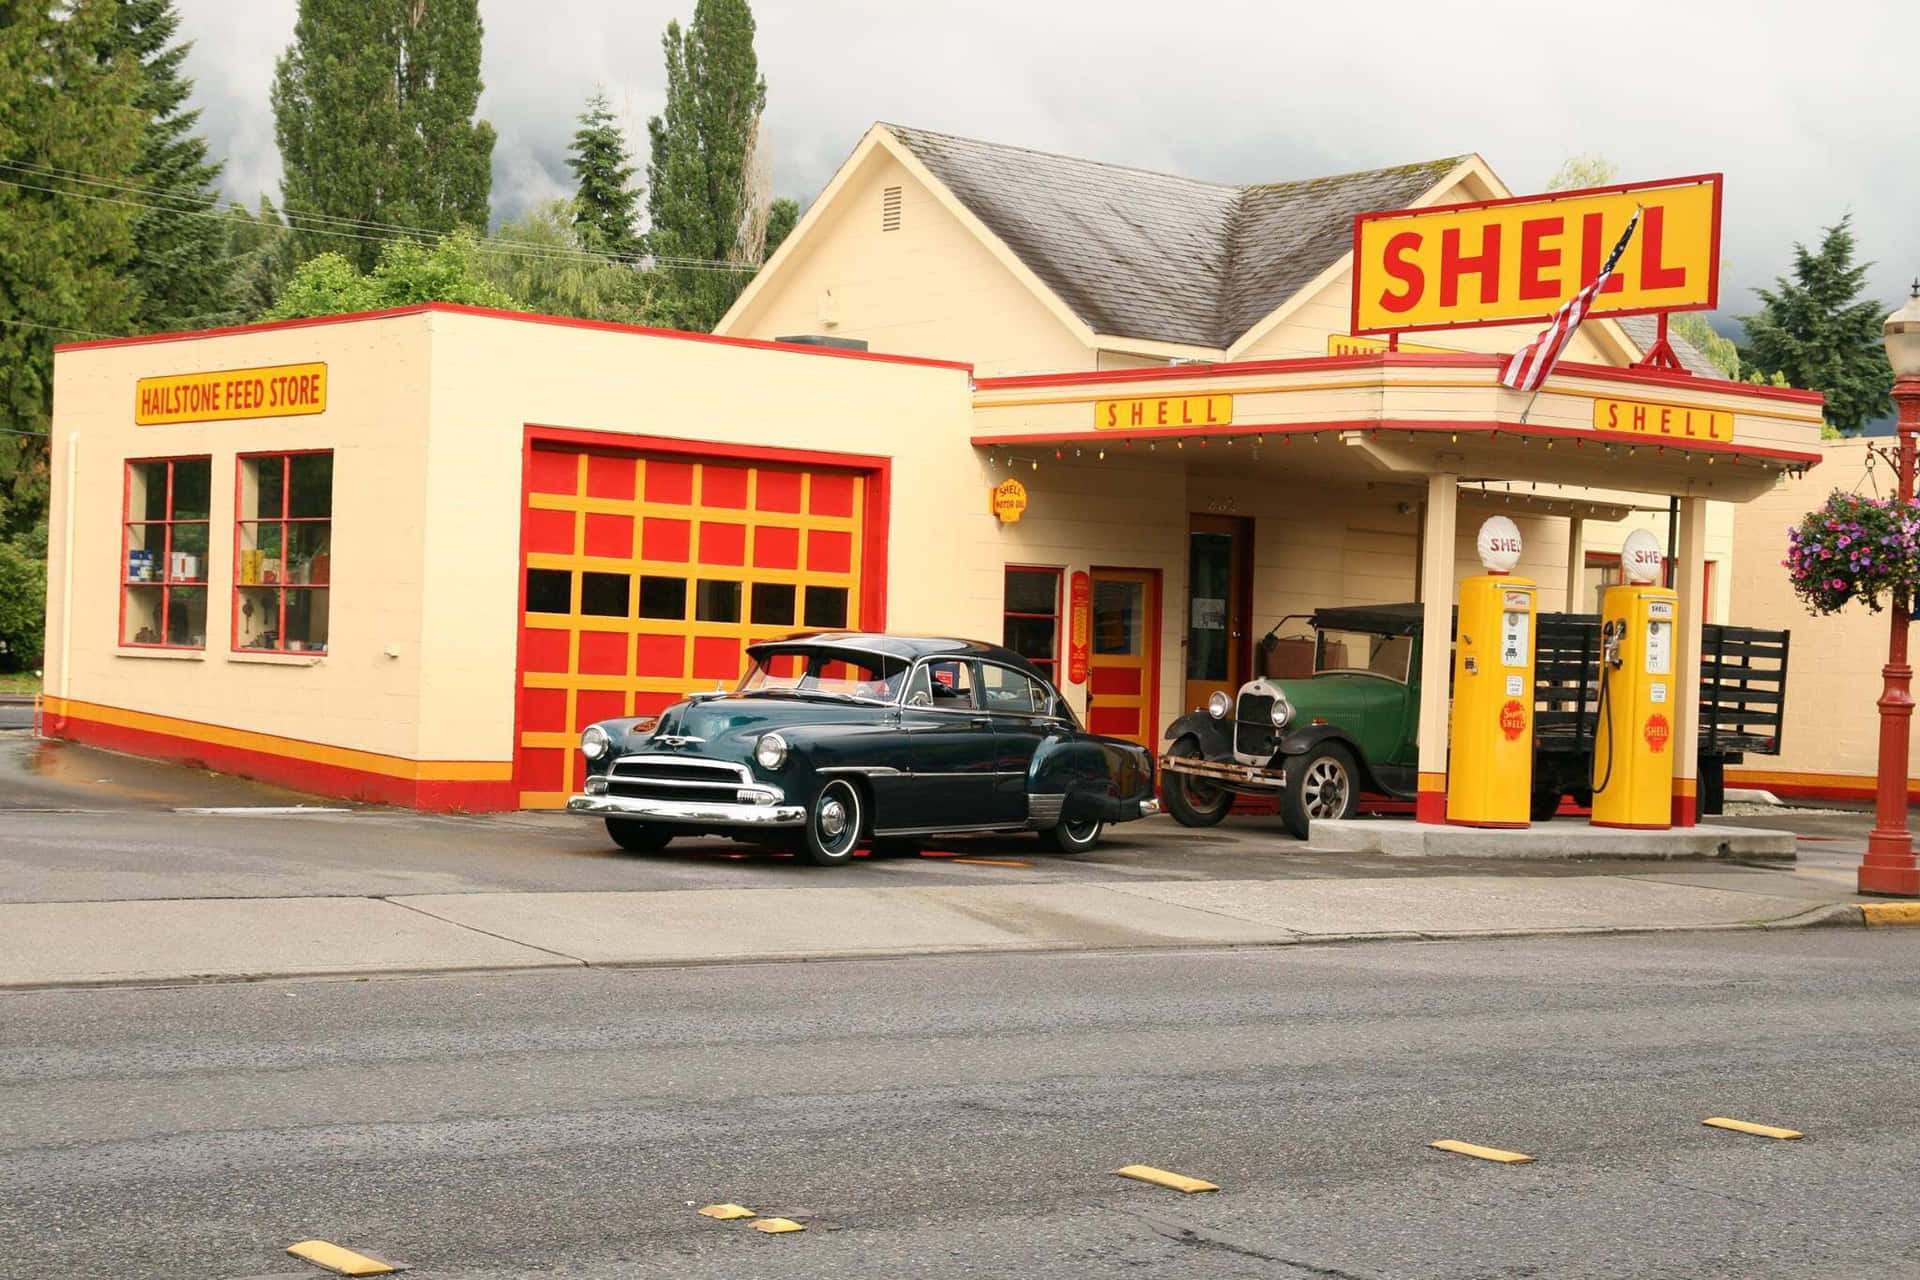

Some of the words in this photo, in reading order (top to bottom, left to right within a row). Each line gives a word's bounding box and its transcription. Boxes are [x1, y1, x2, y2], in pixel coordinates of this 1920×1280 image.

[1379, 206, 1686, 313] SHELL
[142, 382, 220, 416] HAILSTONE
[225, 379, 264, 410] FEED
[269, 374, 320, 407] STORE
[1108, 399, 1216, 427] SHELL
[1608, 403, 1718, 438] SHELL
[999, 484, 1023, 497] SHELL
[1651, 605, 1668, 613] SHELL
[1646, 727, 1668, 736] SHELL
